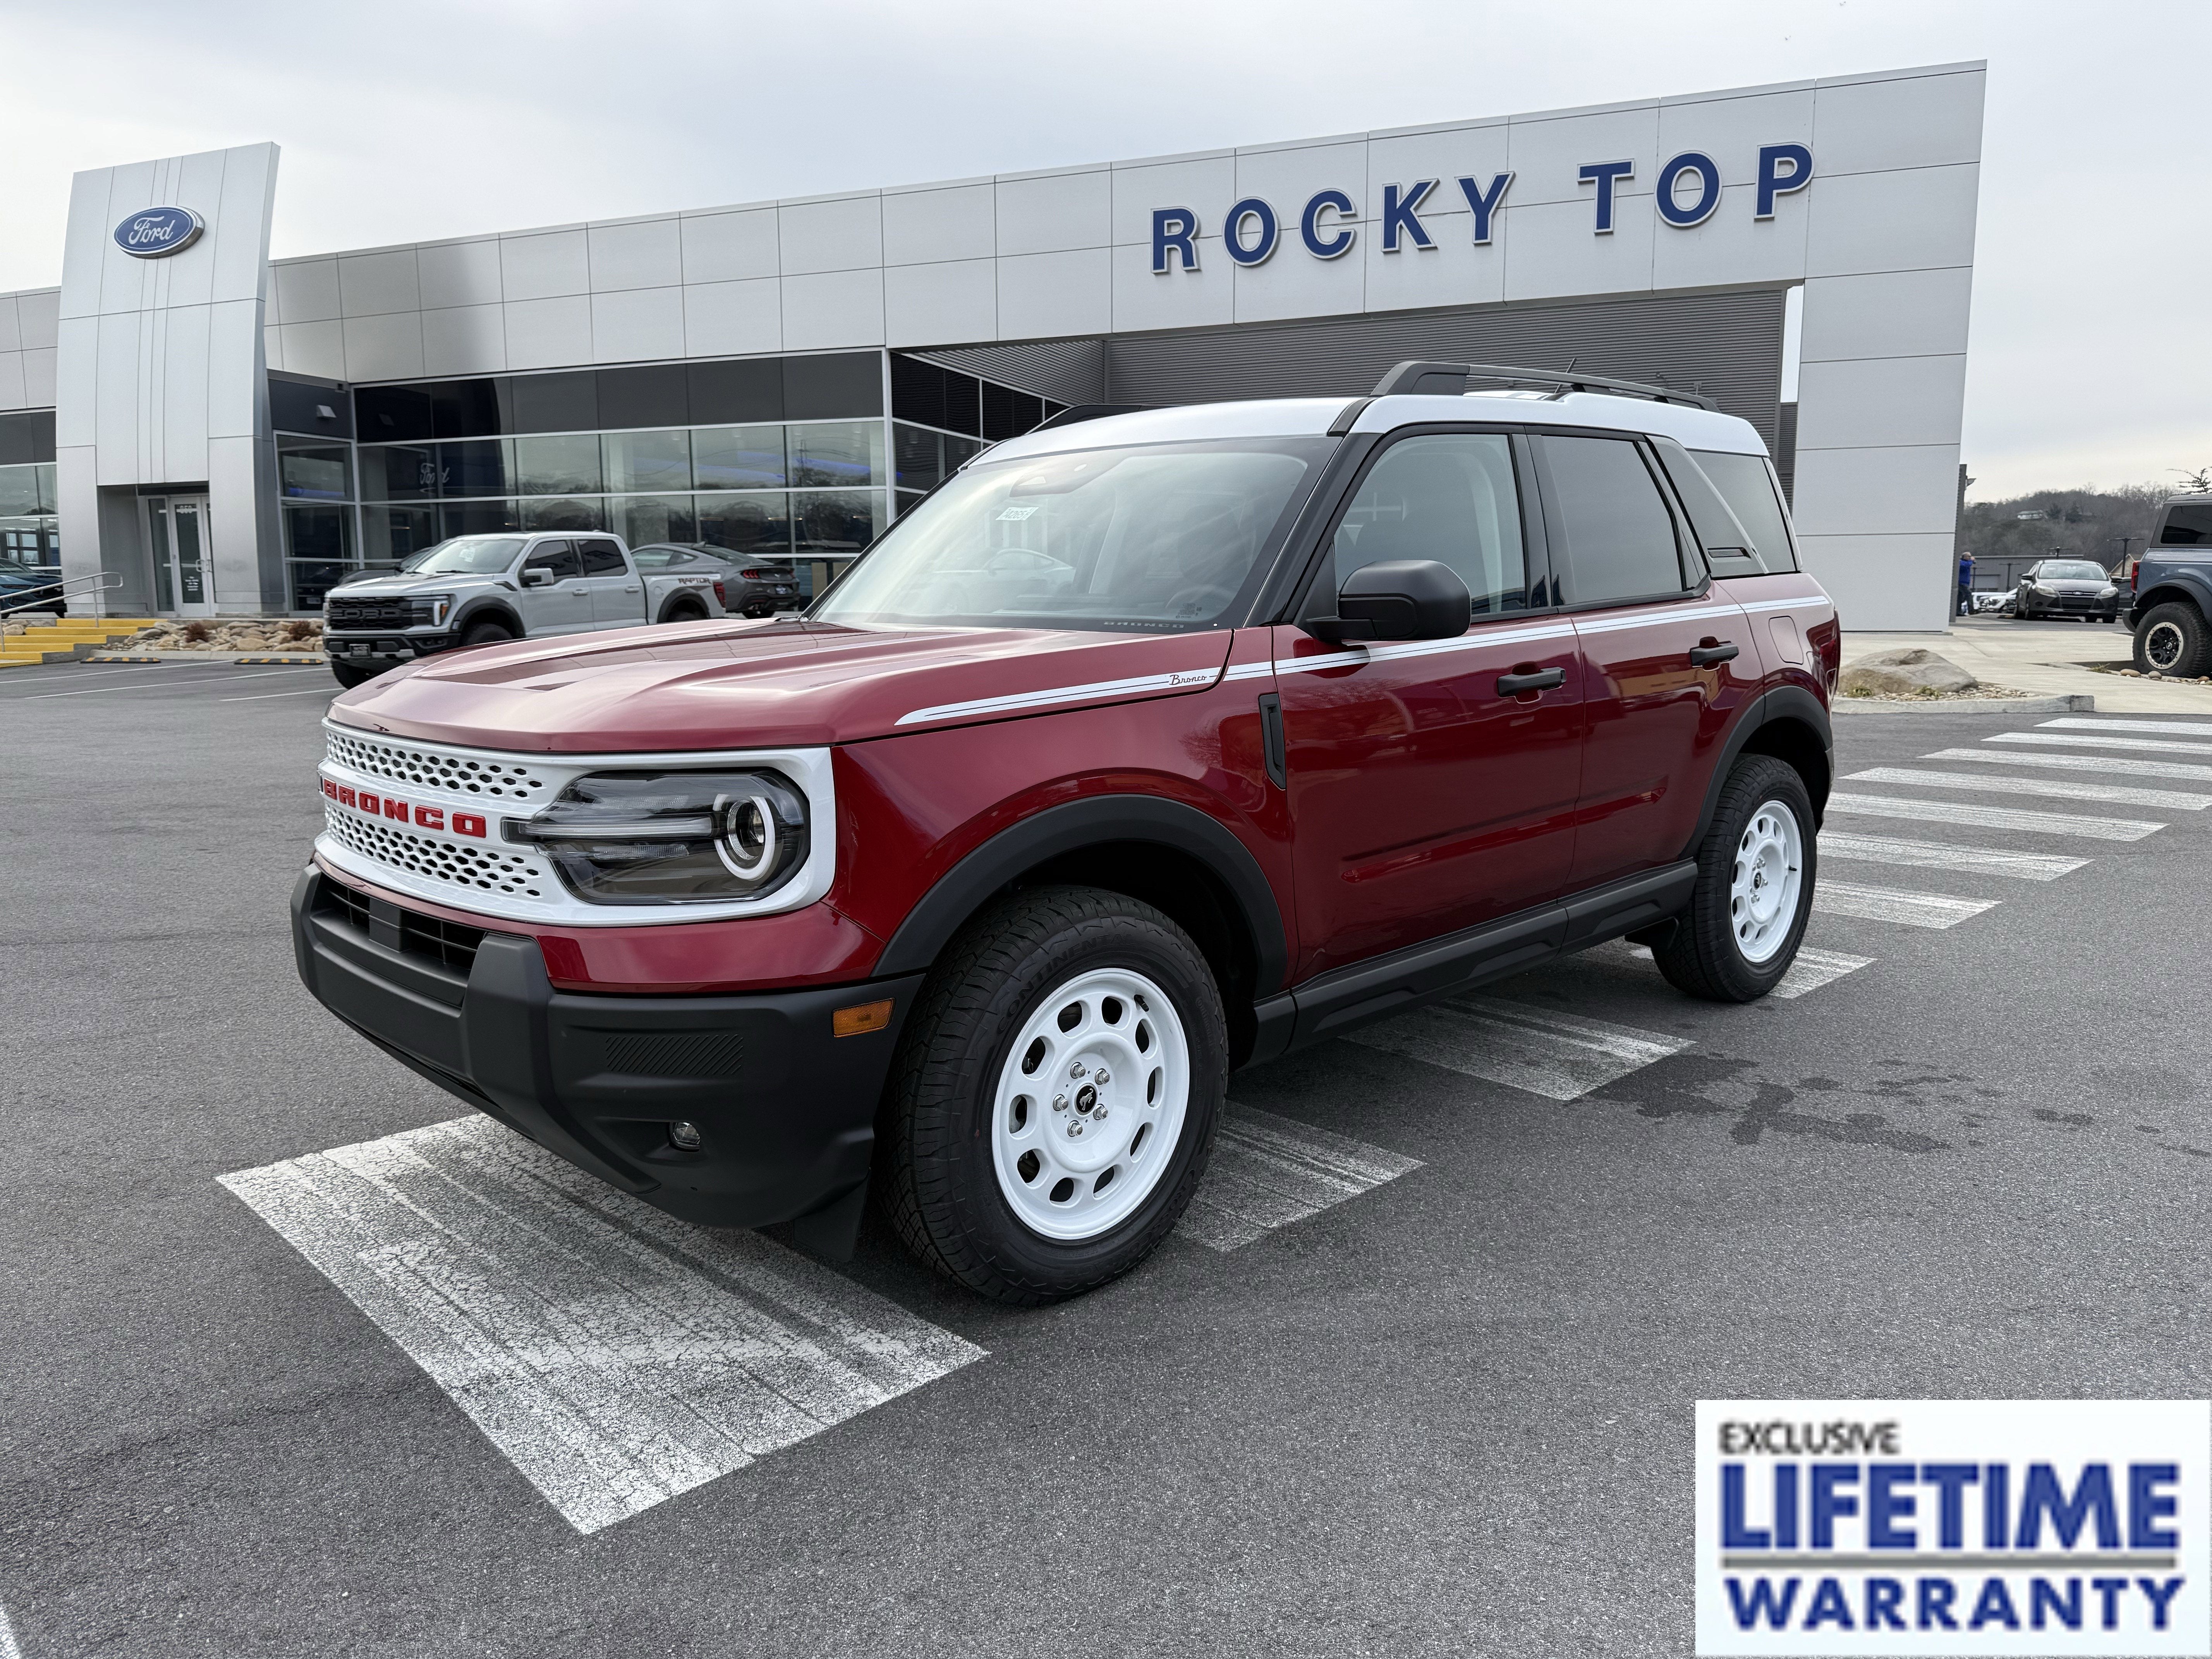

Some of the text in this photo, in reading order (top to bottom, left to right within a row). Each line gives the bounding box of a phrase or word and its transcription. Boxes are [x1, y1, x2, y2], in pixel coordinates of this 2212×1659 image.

[1151, 142, 1814, 273] ROCKY TOP
[129, 216, 176, 245] Ford
[329, 609, 402, 620] FORD
[1169, 675, 1207, 685] Bronco
[324, 778, 486, 838] BRONCO
[997, 934, 1135, 1035] CONTINENTAL
